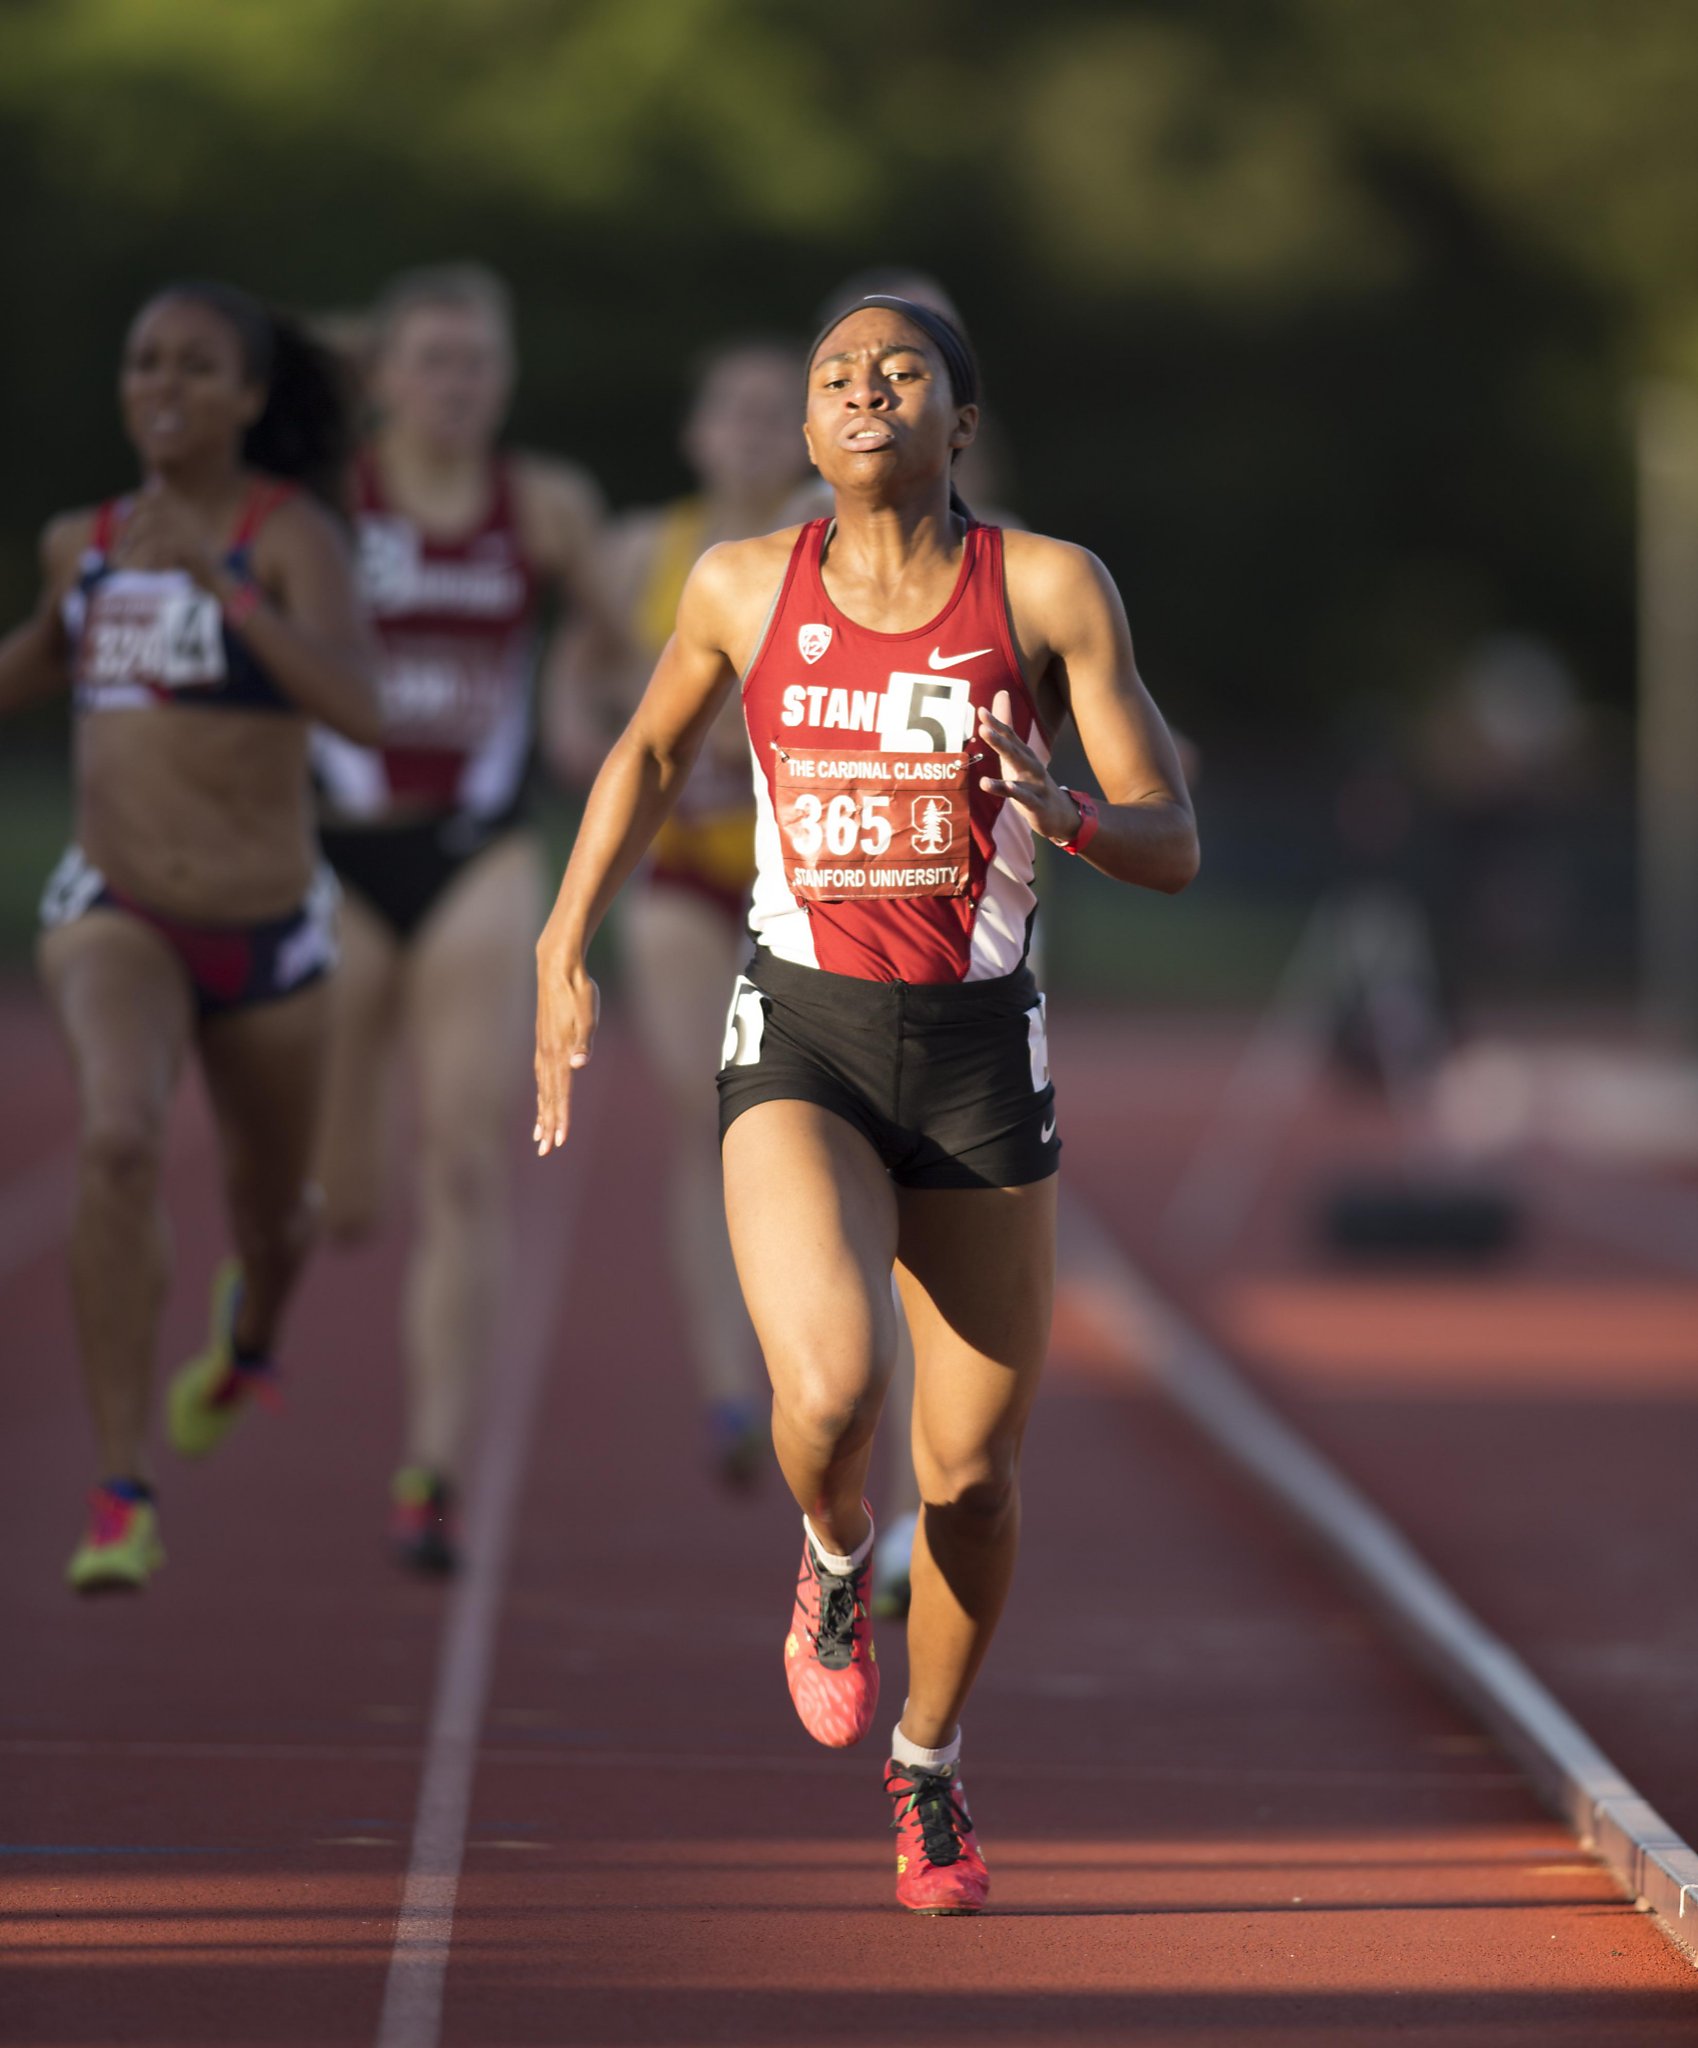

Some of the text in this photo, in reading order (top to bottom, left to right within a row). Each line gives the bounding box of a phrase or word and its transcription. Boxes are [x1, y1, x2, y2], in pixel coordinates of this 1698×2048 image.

[907, 682, 952, 752] 5
[788, 759, 957, 780] THE CARDINAL CLASSIC
[791, 793, 892, 856] 365
[794, 866, 958, 888] STANFORD UNIVERSITY
